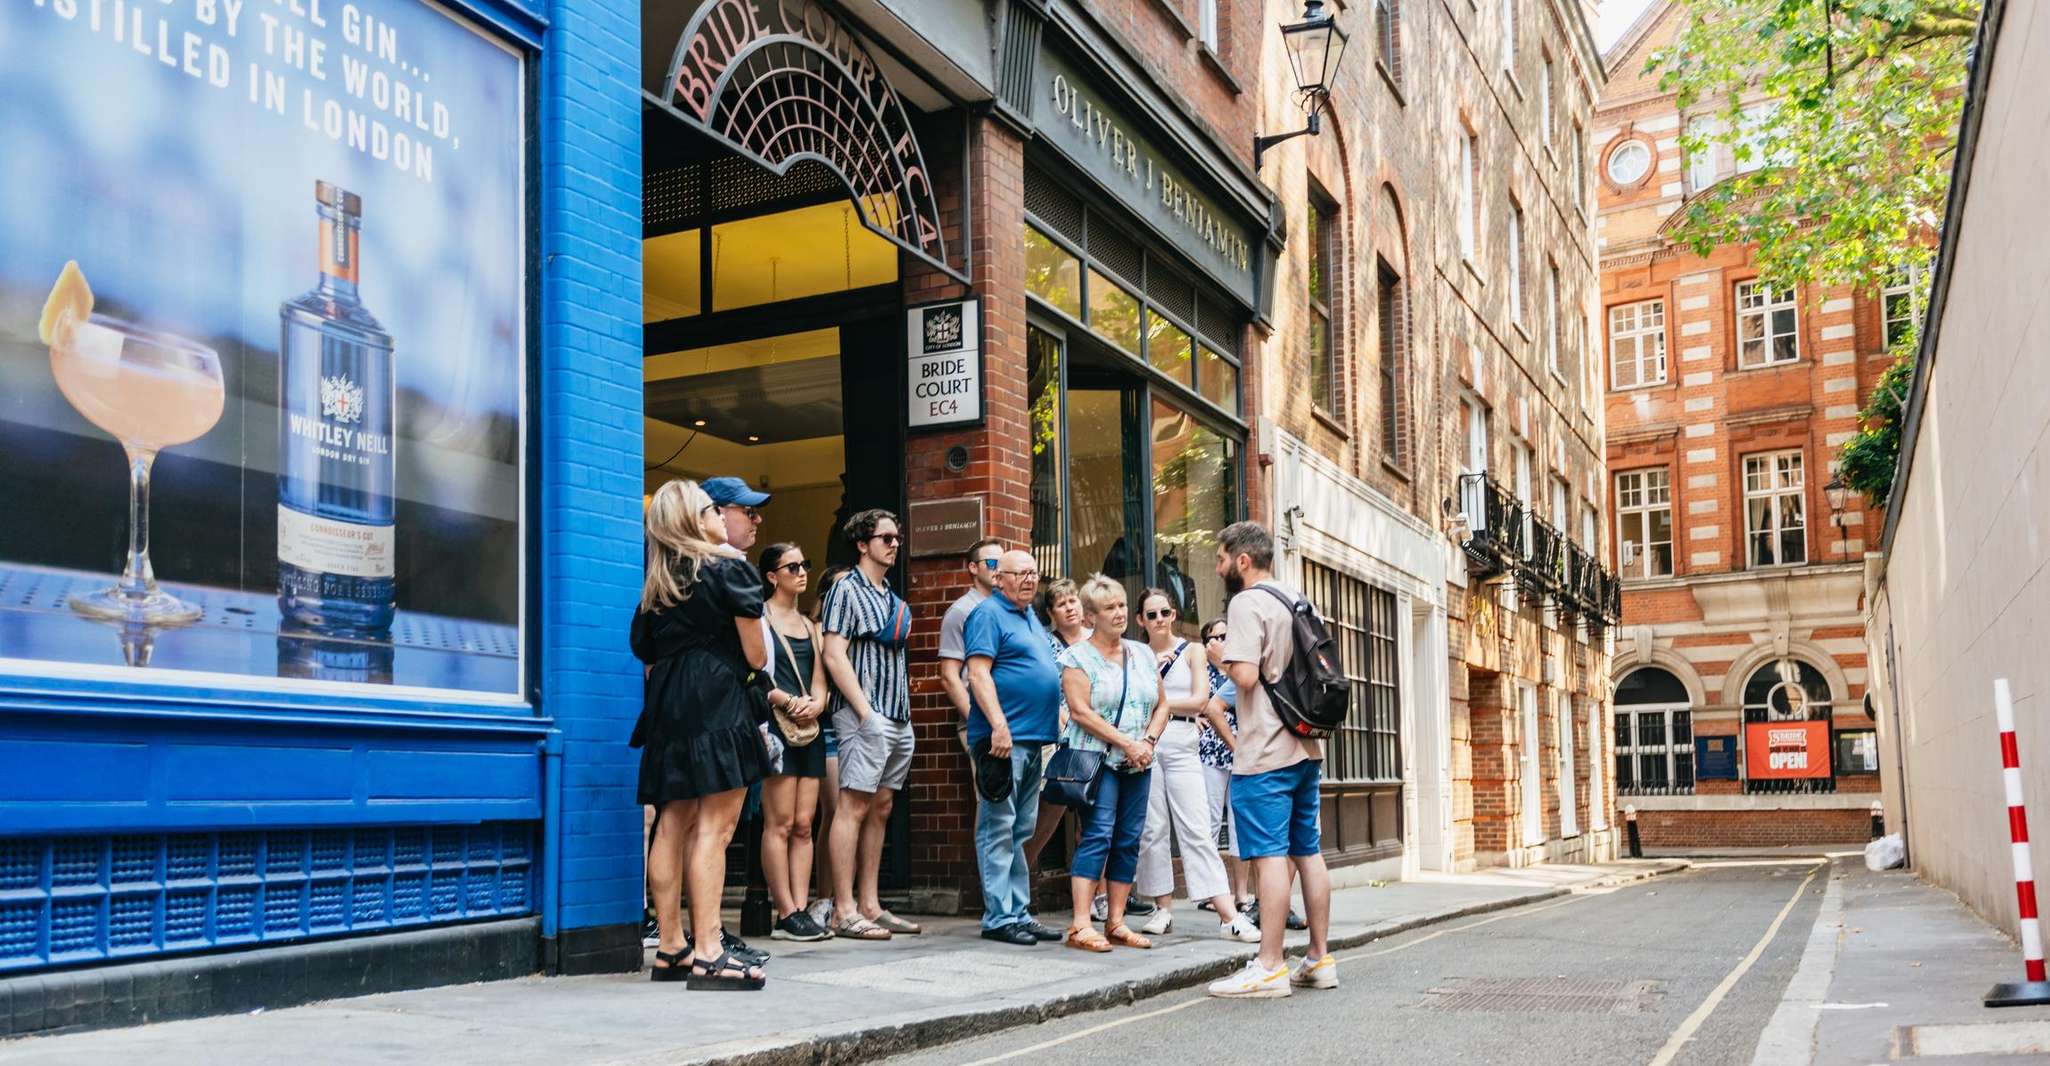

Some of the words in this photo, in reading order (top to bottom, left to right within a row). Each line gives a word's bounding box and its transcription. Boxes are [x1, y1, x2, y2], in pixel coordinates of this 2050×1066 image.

[342, 4, 429, 82] GIN...
[675, 0, 770, 123] BRIDE
[778, 0, 896, 121] COURT
[260, 12, 326, 80] THE
[342, 53, 459, 150] WORLD,
[249, 63, 285, 116] IN
[303, 88, 432, 182] LONDON
[1054, 74, 1138, 179] OLIVER
[1146, 158, 1153, 190] J
[1162, 171, 1248, 272] BENJAMIN
[915, 378, 972, 399] COURT
[921, 359, 966, 379] BRIDE
[929, 400, 958, 417] EC4
[290, 413, 352, 448] WHITLEY
[356, 432, 388, 454] NEILL
[311, 446, 340, 460] LONDON
[342, 454, 356, 463] DRY
[1769, 752, 1808, 769] OPEN!
